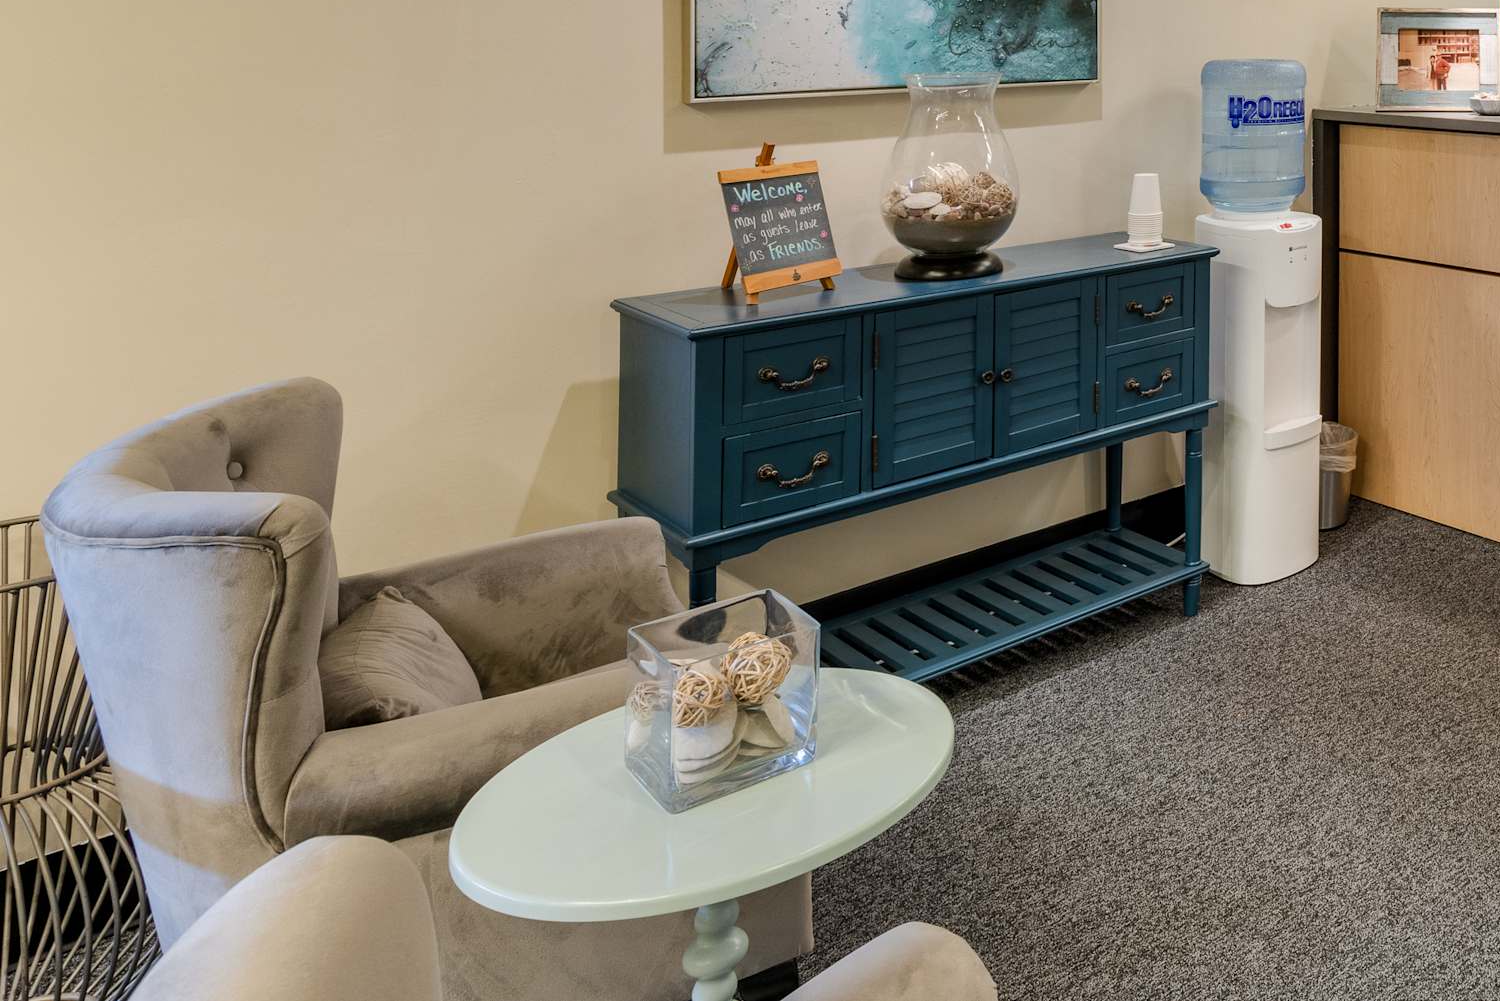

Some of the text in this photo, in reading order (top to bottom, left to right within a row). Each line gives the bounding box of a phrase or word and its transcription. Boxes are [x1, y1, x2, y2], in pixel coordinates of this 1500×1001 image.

[761, 209, 774, 223] all
[778, 207, 797, 219] who
[743, 218, 819, 246] as guests leave
[749, 249, 766, 263] as
